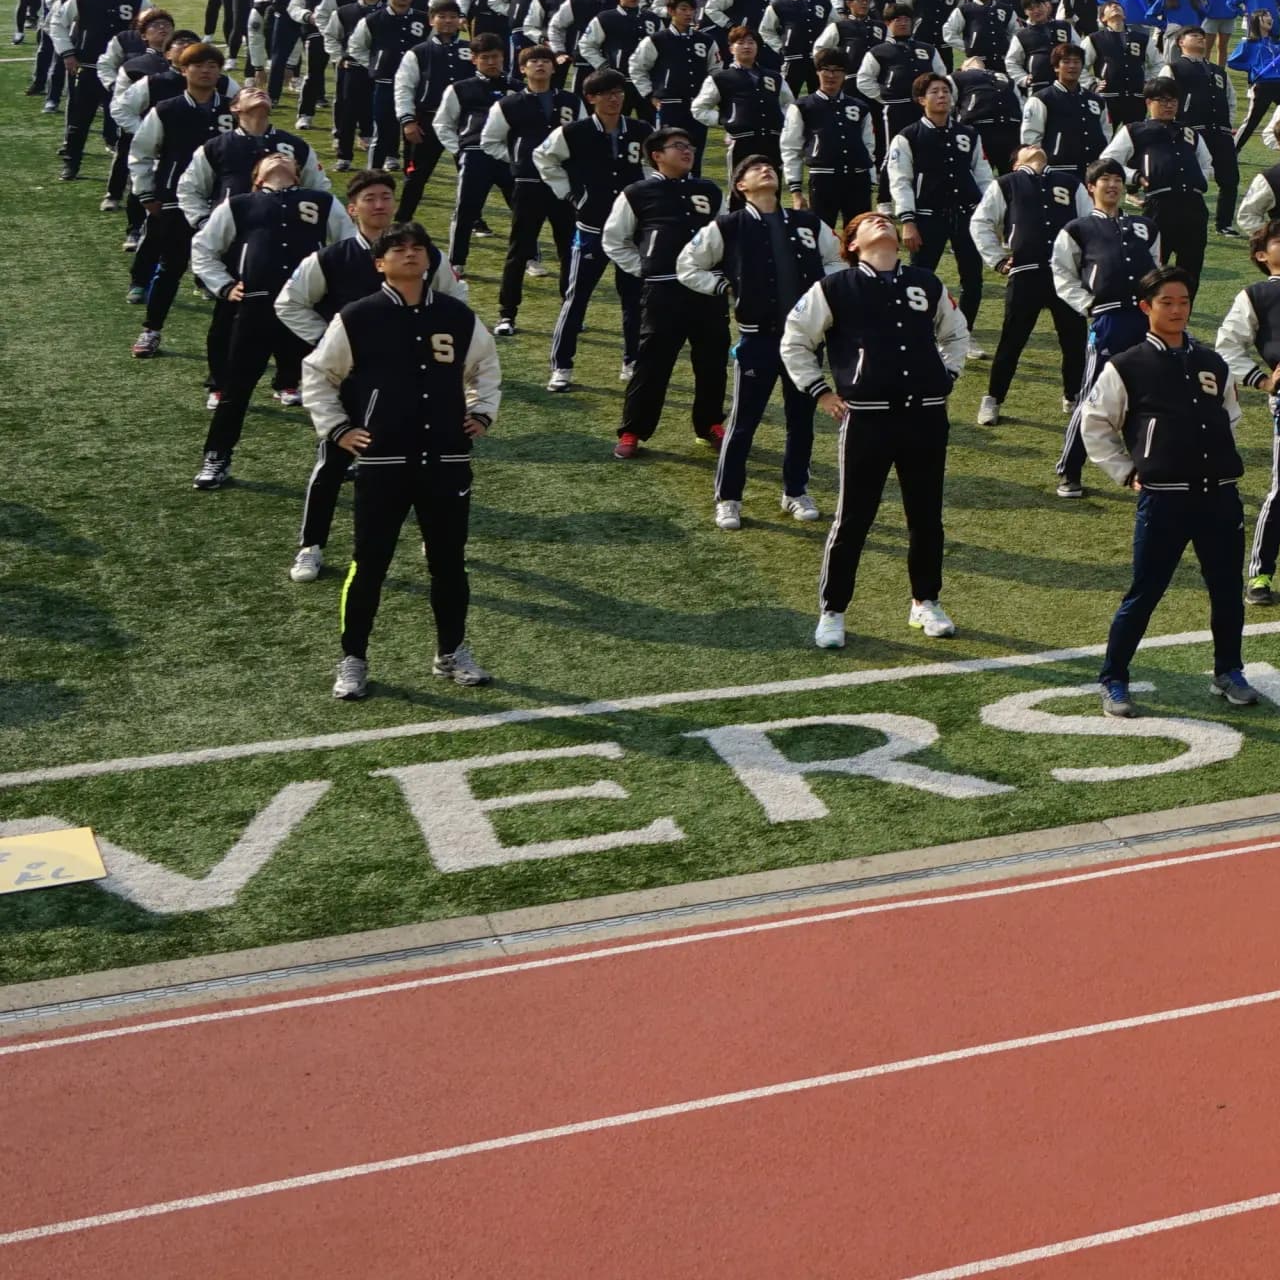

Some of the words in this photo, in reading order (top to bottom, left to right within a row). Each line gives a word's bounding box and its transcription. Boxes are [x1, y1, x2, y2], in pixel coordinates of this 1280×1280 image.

[628, 142, 640, 164] S
[956, 134, 970, 152] S
[691, 194, 711, 214] S
[1052, 186, 1070, 206] S
[298, 201, 318, 224] S
[797, 227, 816, 249] S
[1133, 222, 1148, 241] S
[906, 286, 928, 312] S
[432, 334, 454, 363] S
[1198, 371, 1218, 396] S
